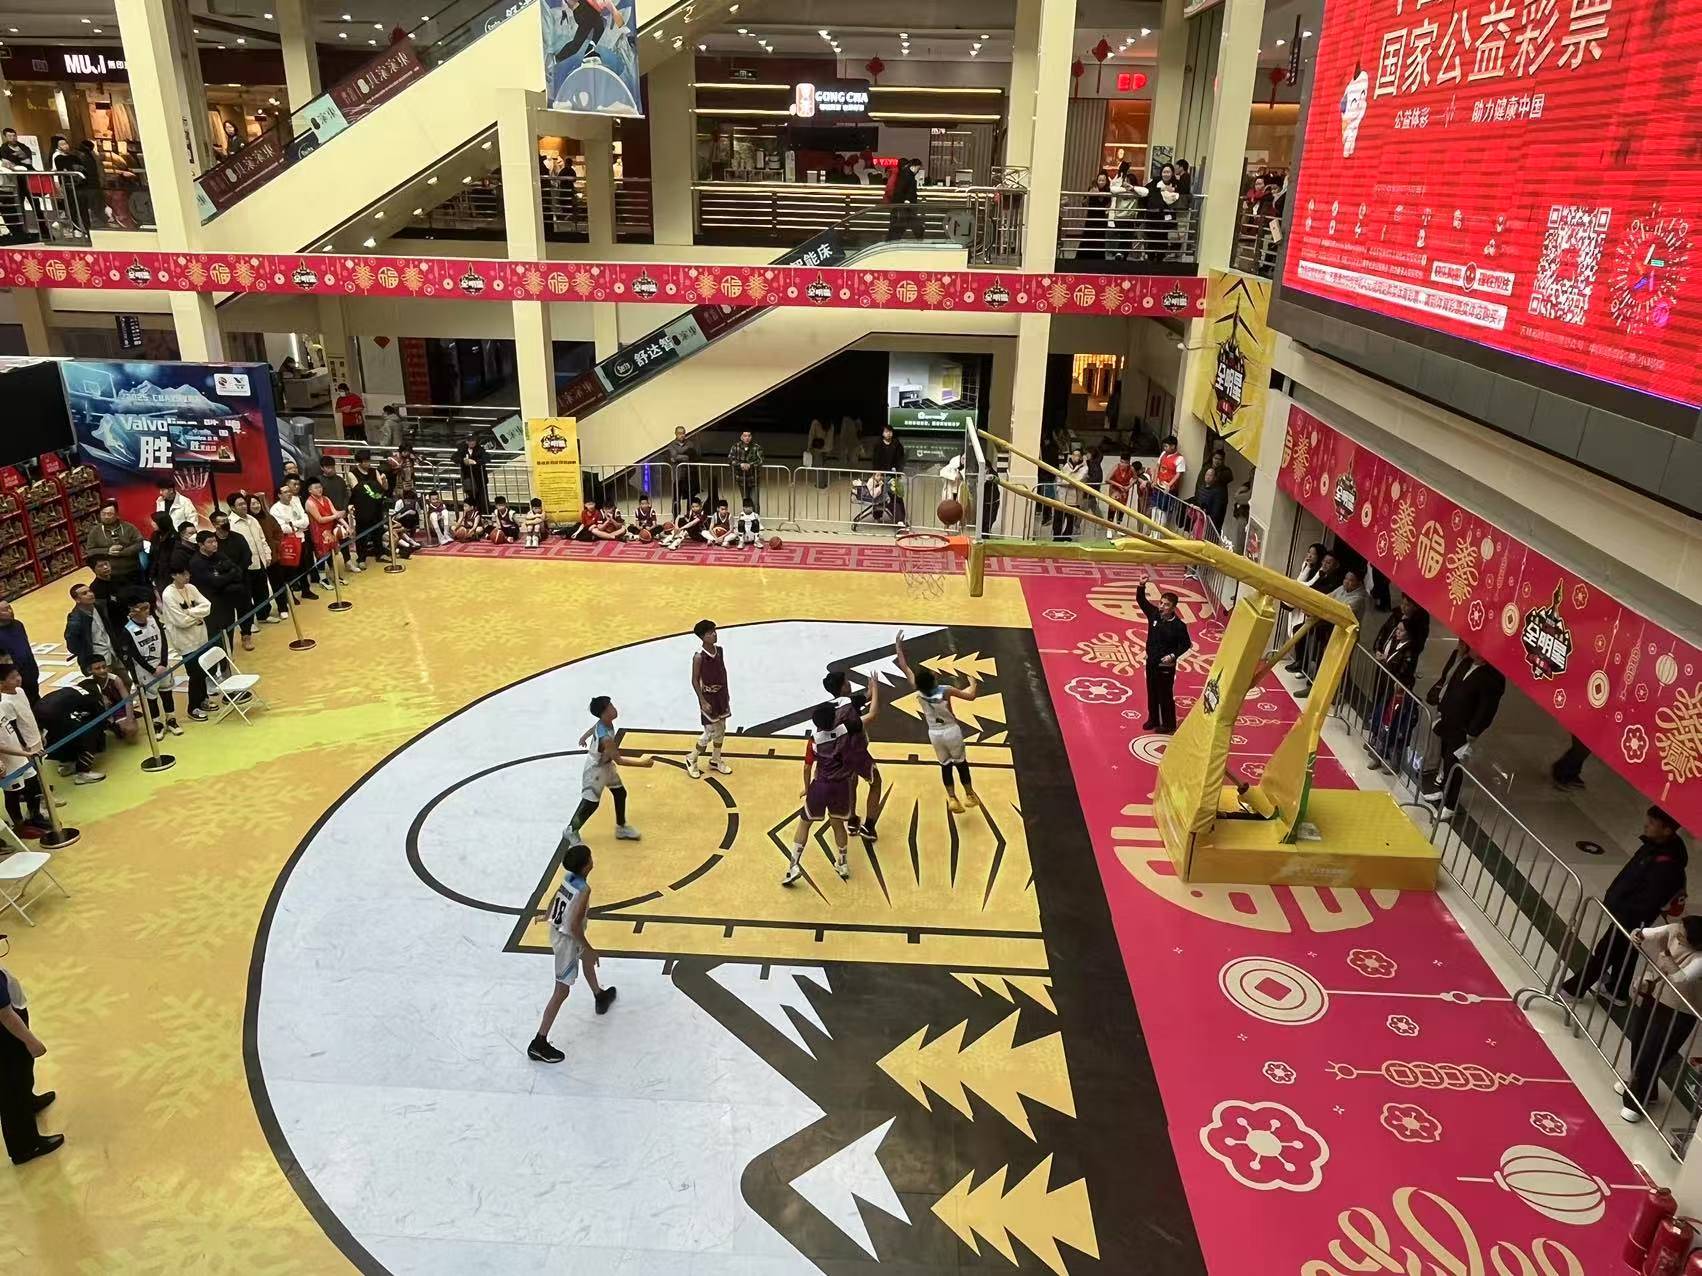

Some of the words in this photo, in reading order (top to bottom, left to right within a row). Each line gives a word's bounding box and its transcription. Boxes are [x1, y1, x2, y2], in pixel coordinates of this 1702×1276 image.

[64, 54, 107, 74] MUJI
[1373, 0, 1612, 99] 国家公益彩票
[815, 91, 845, 103] GONG
[846, 92, 868, 103] CHA
[1394, 107, 1430, 129] 公益体彩
[1471, 93, 1546, 122] 助力健康中国
[139, 435, 174, 469] 胜
[1522, 621, 1568, 670] 全明星
[551, 897, 567, 924] 18
